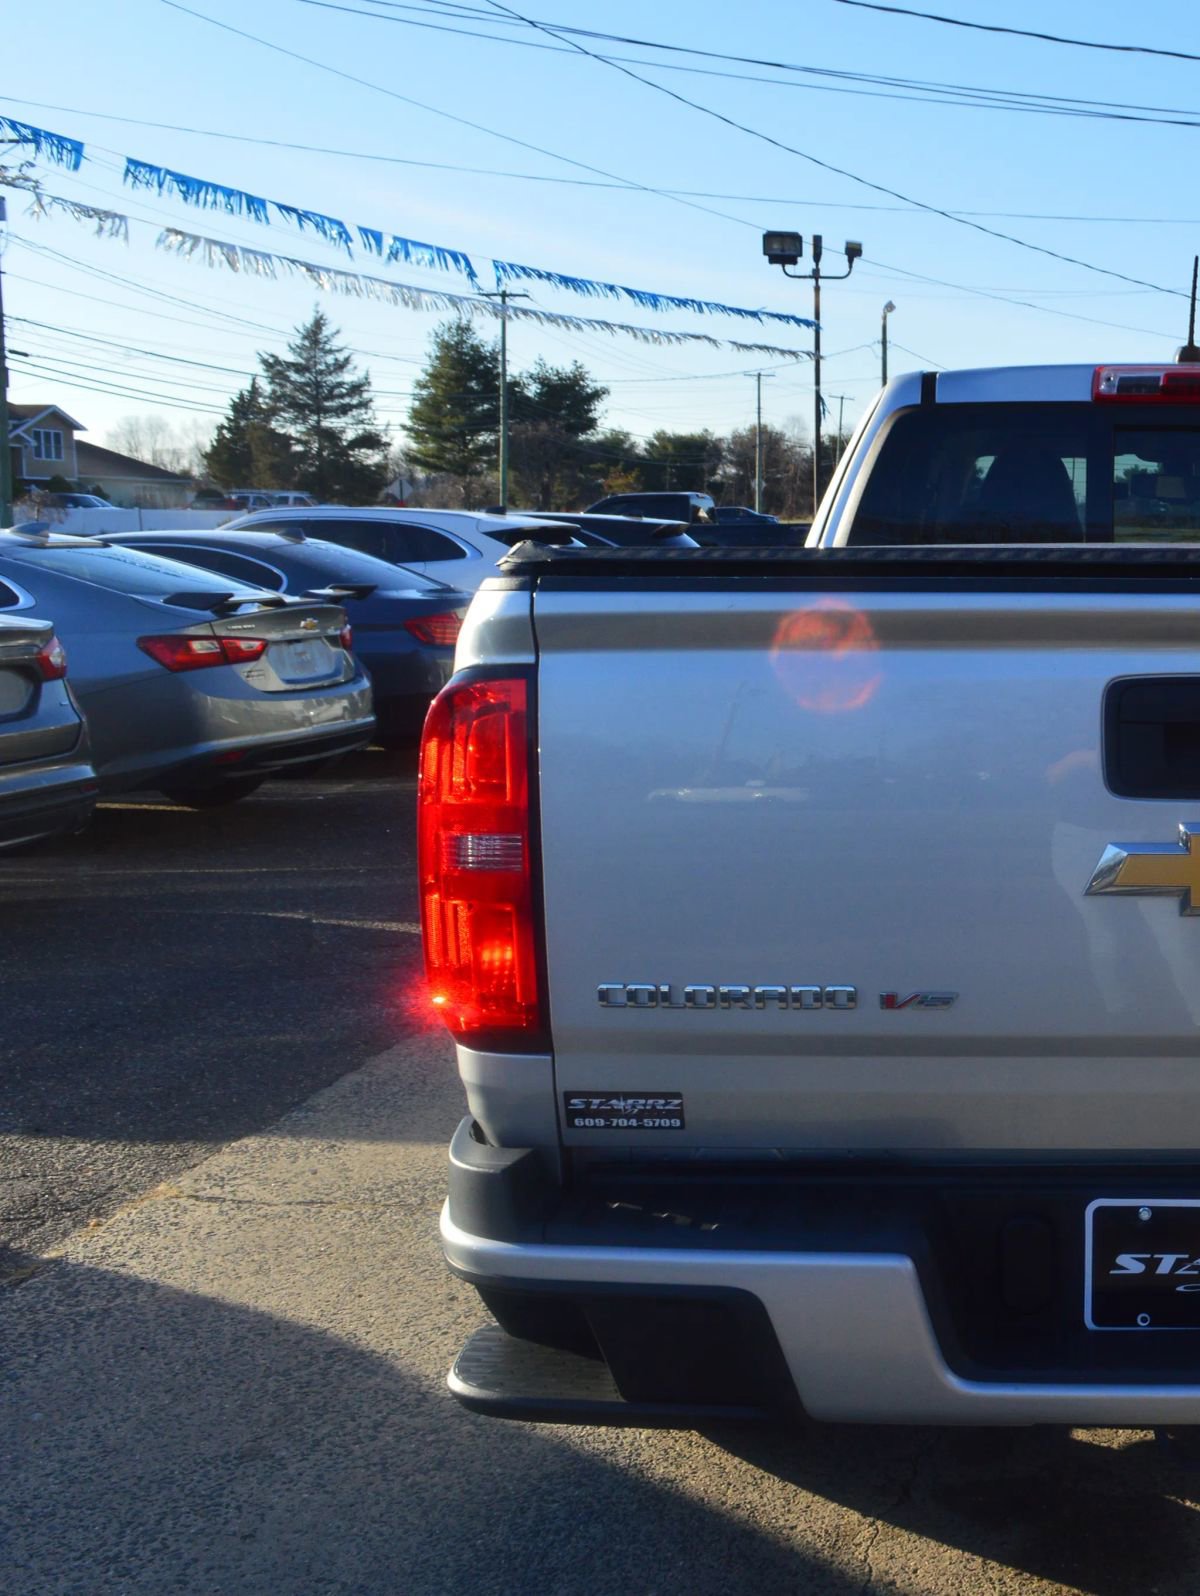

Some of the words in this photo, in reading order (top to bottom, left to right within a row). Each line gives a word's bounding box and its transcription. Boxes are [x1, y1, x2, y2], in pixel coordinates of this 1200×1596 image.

[596, 982, 858, 1011] COLORADO
[567, 1097, 683, 1110] STARRZ
[574, 1117, 681, 1128] 609-704-5709
